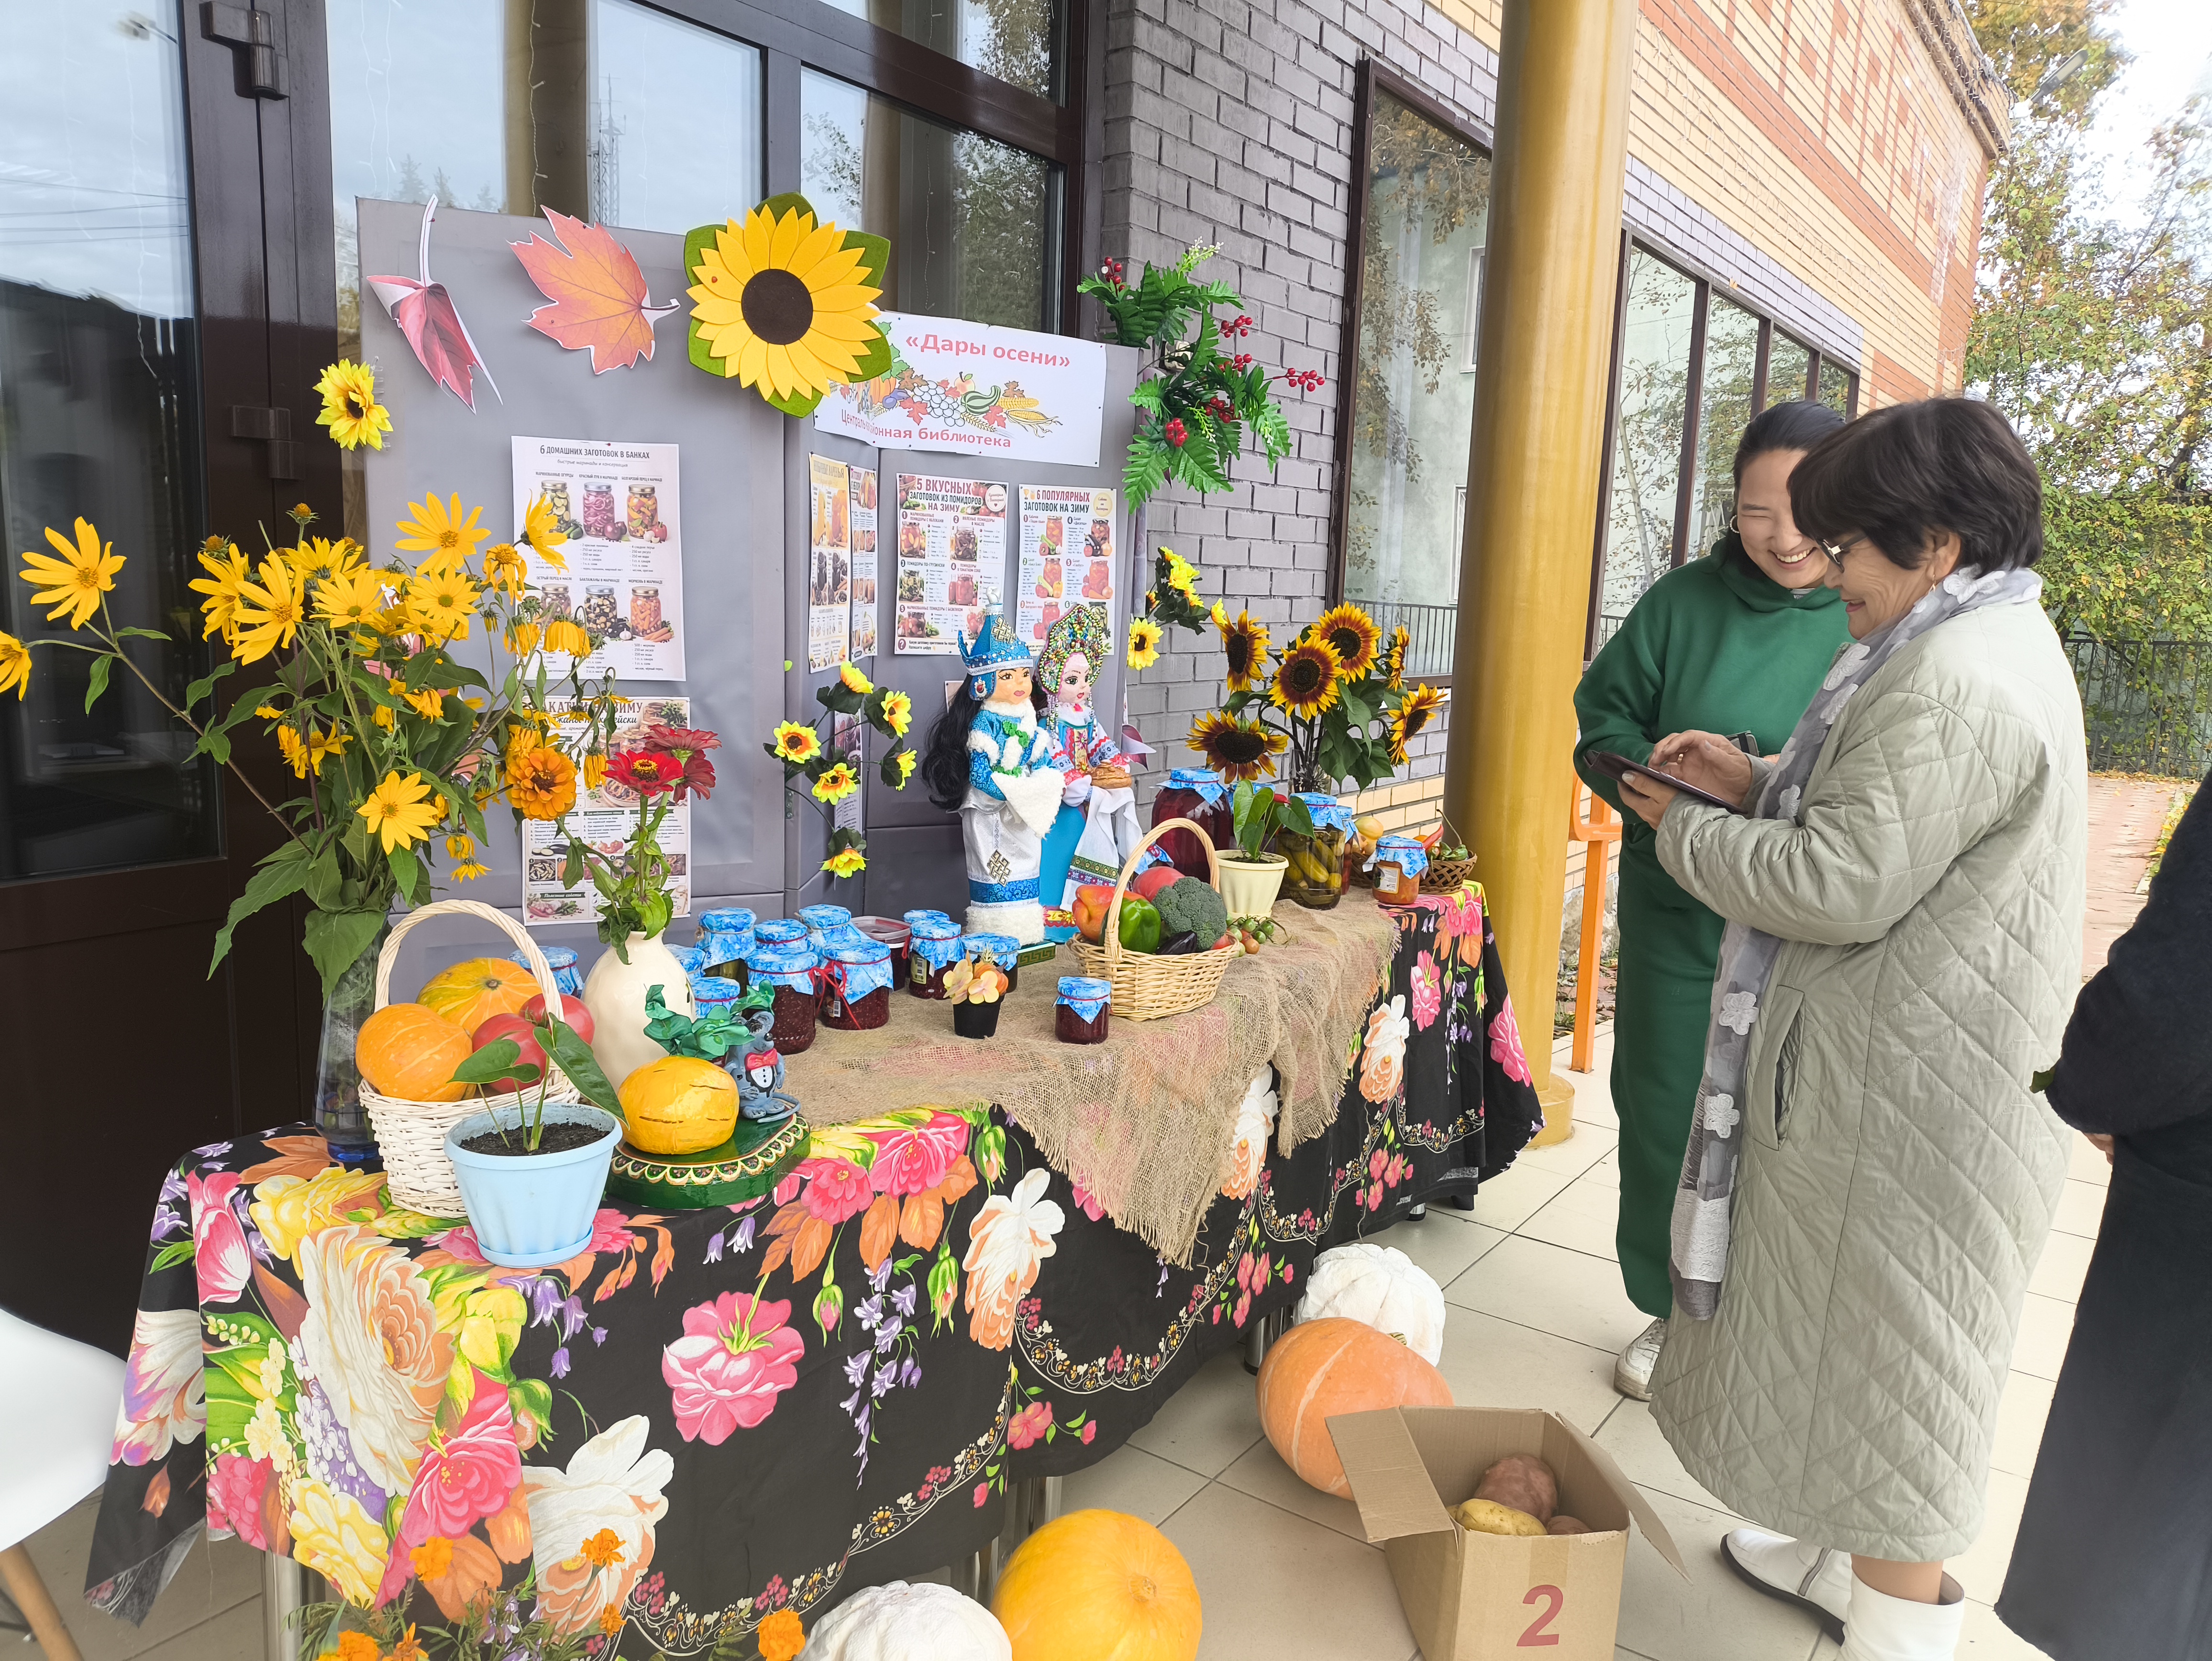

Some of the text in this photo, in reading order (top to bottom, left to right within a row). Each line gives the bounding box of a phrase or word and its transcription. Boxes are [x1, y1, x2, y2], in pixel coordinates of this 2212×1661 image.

[906, 334, 1070, 367] «Дары осени»
[918, 427, 1011, 448] библиотека
[540, 445, 545, 454] 6
[546, 446, 583, 455] ДОМАШНИХ
[584, 449, 619, 457] ЗАГОТОВОК
[917, 478, 972, 495] 5 ВКУСНЫХ
[909, 491, 940, 502] ЗАГОТОВОК
[950, 495, 982, 505] ПОМИДОРОВ
[1037, 489, 1090, 502] 6 ПОПУЛЯРНЫХ
[928, 502, 960, 512] НА ЗИМУ
[1024, 501, 1090, 513] ЗАГОТОВОК НА ЗИМУ
[1516, 1584, 1564, 1647] 2
